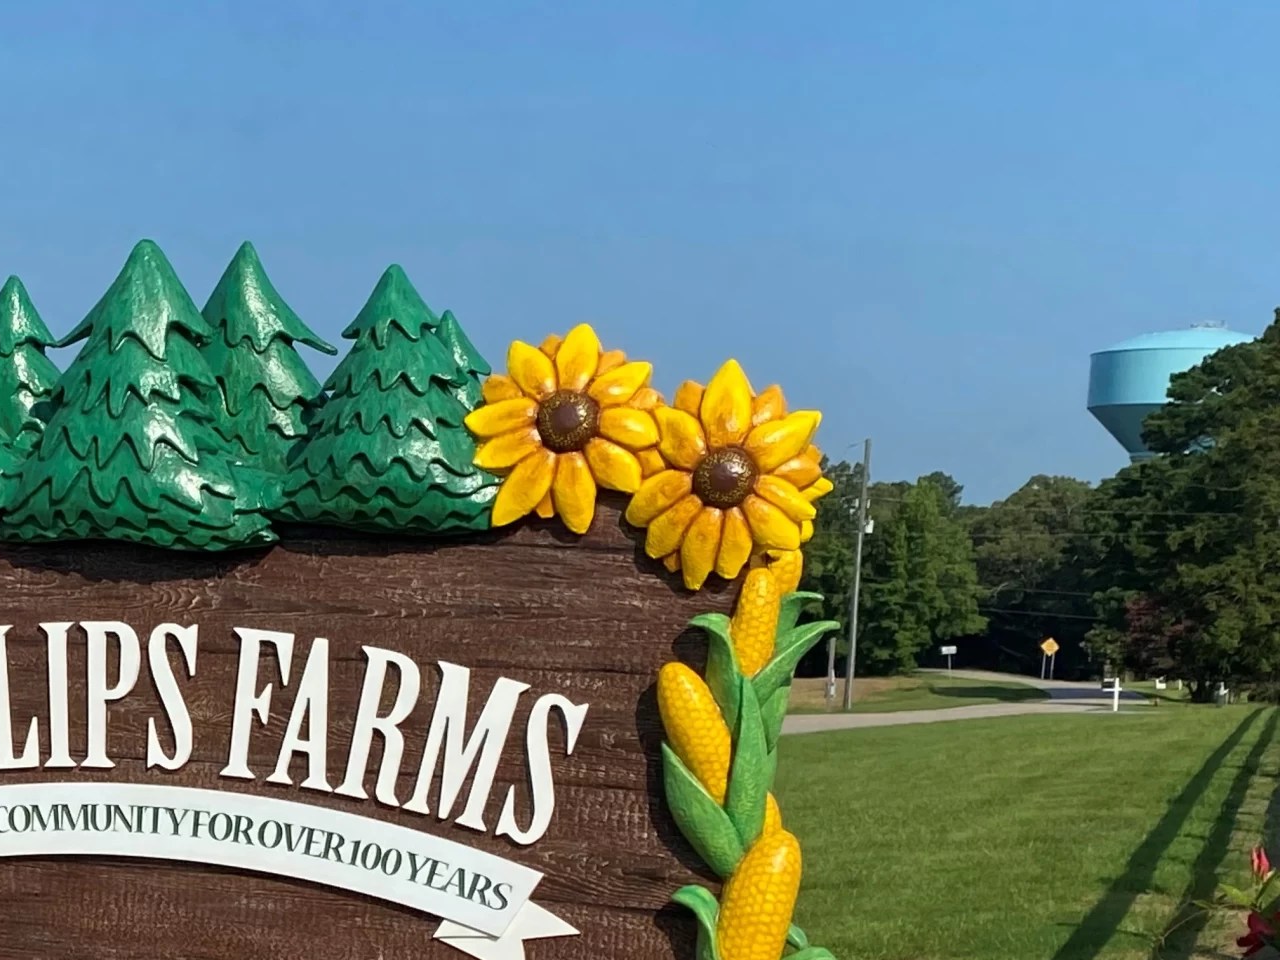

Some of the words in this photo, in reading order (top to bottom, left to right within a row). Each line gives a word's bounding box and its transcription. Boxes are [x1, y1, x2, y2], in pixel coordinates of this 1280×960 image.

[219, 626, 590, 846] FARMS
[190, 810, 255, 846] FOR
[257, 819, 346, 864] OVER
[348, 839, 402, 876] 100
[405, 851, 513, 911] YEARS
